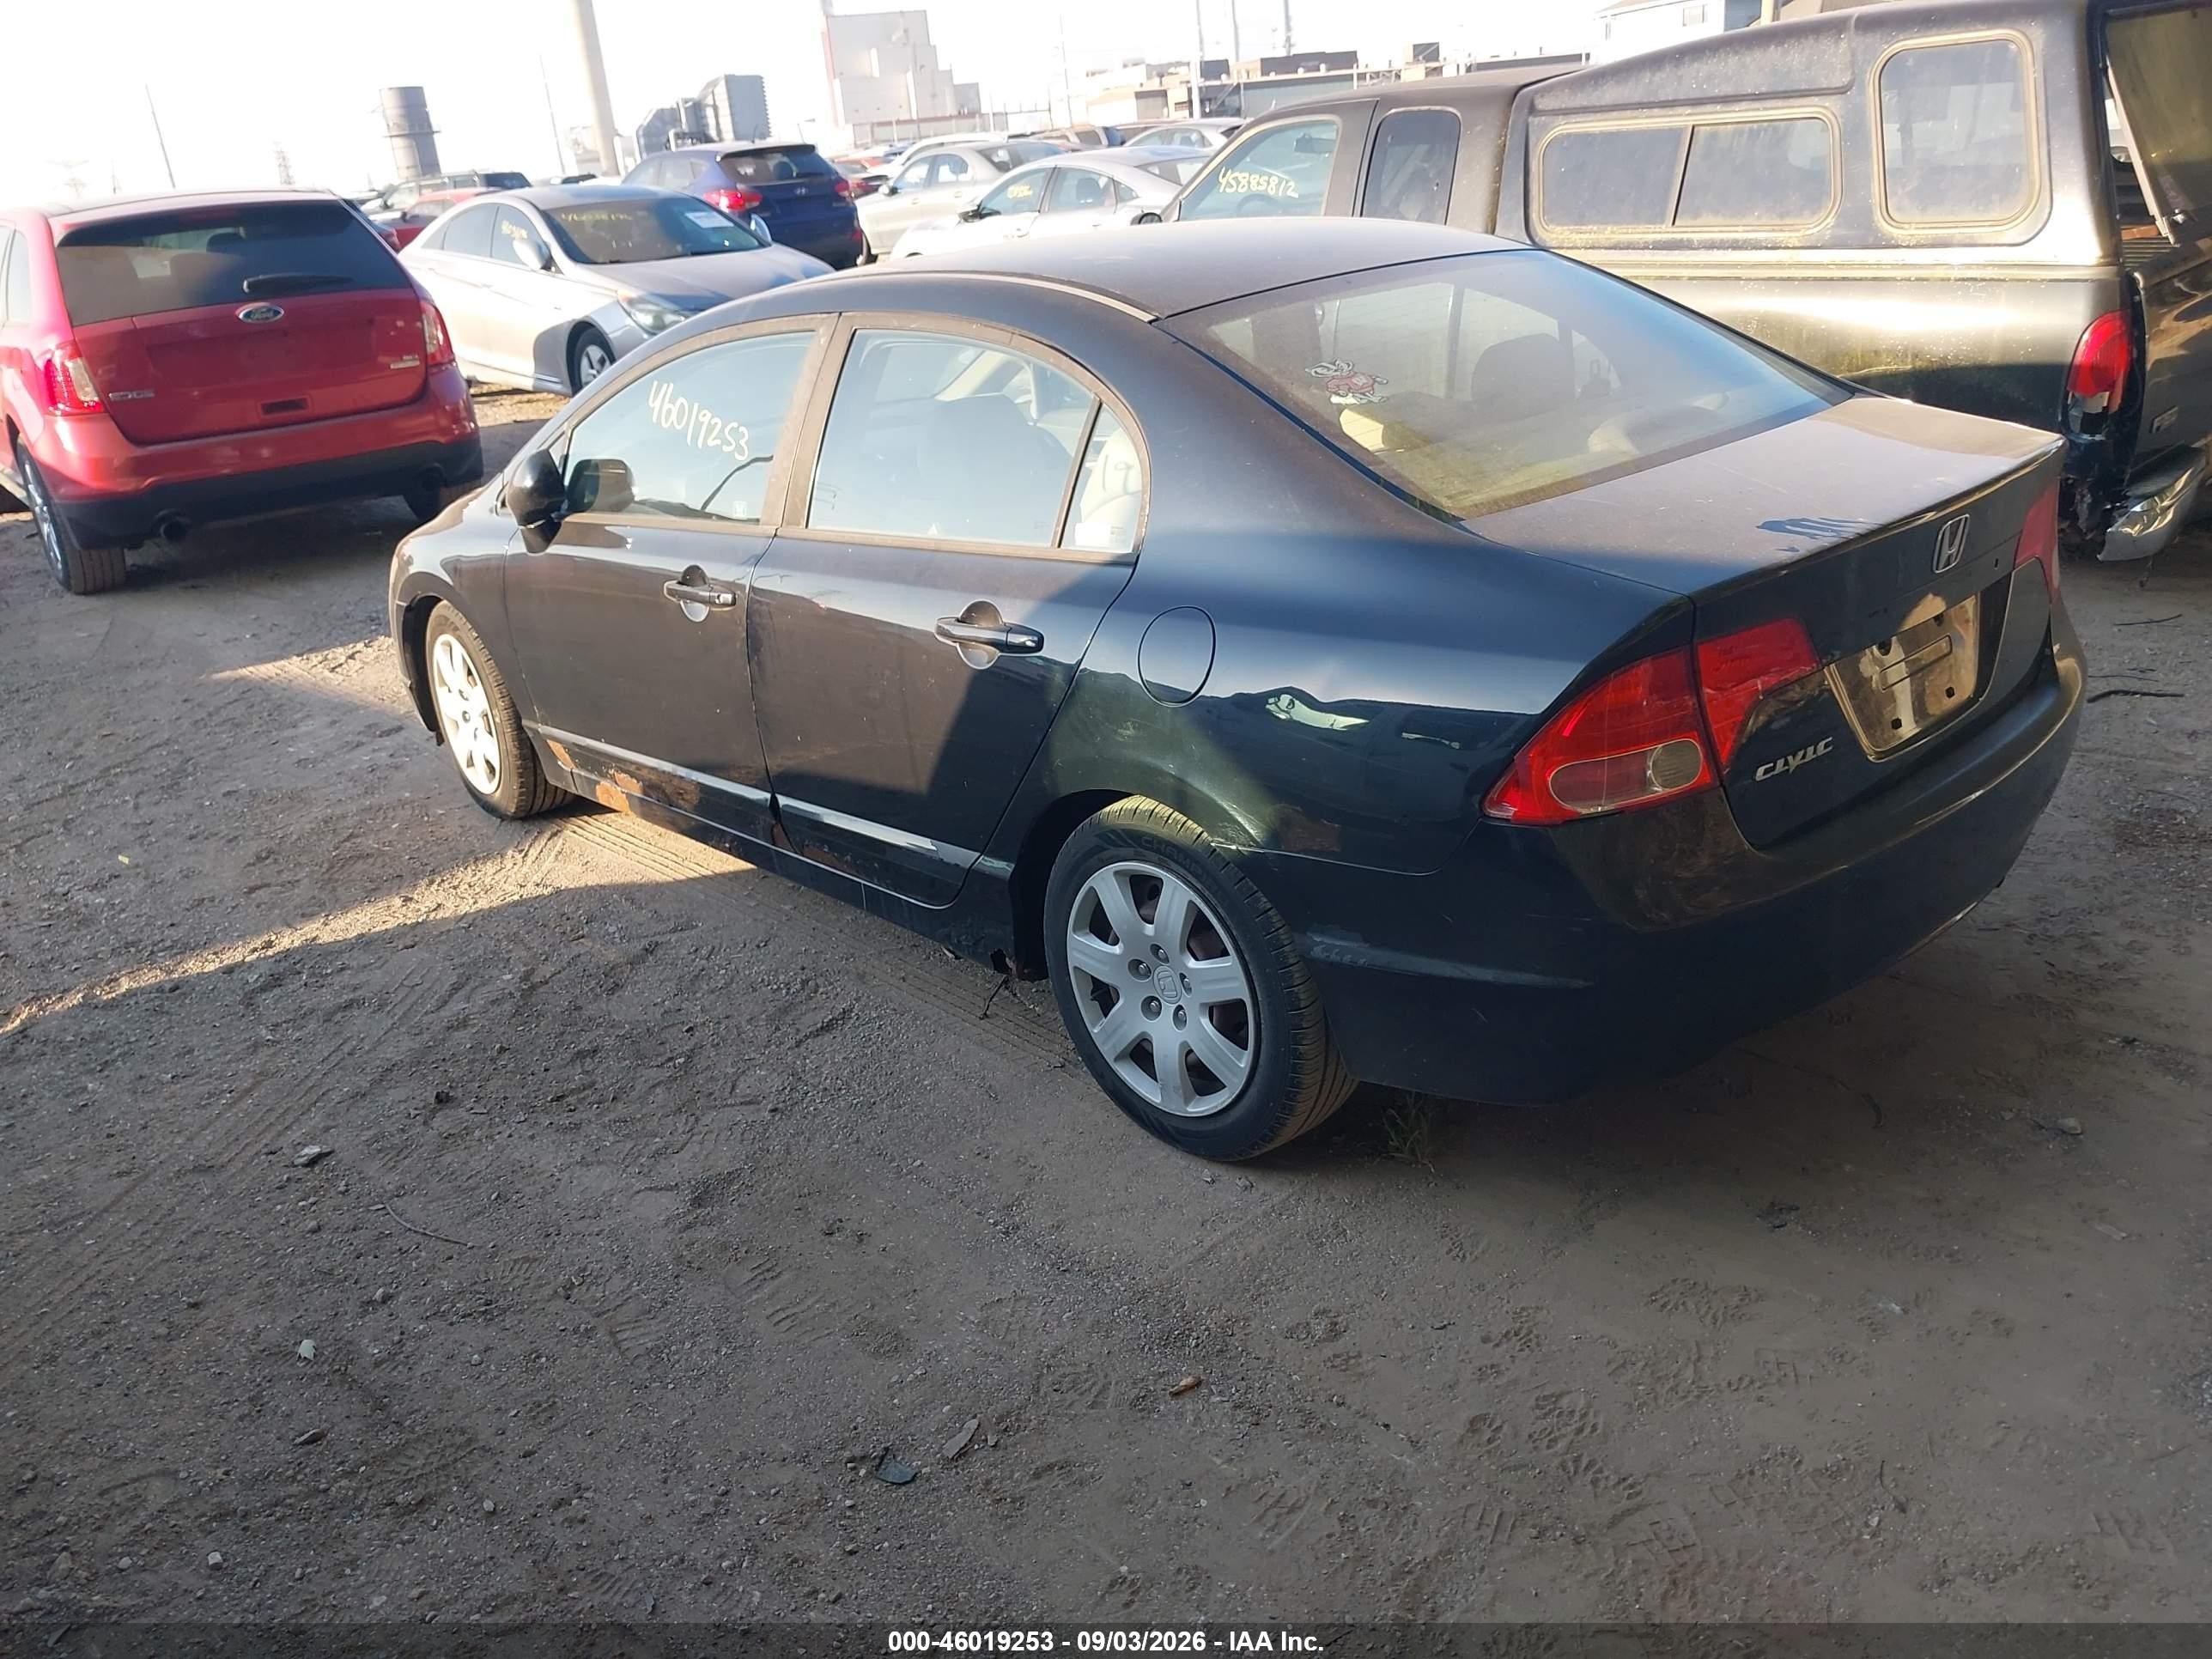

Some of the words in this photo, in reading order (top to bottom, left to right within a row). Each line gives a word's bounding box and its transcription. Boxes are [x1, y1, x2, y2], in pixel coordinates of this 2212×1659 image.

[1218, 167, 1299, 199] 45885812
[647, 380, 750, 461] 46019253
[1755, 737, 1833, 782] CIVIC
